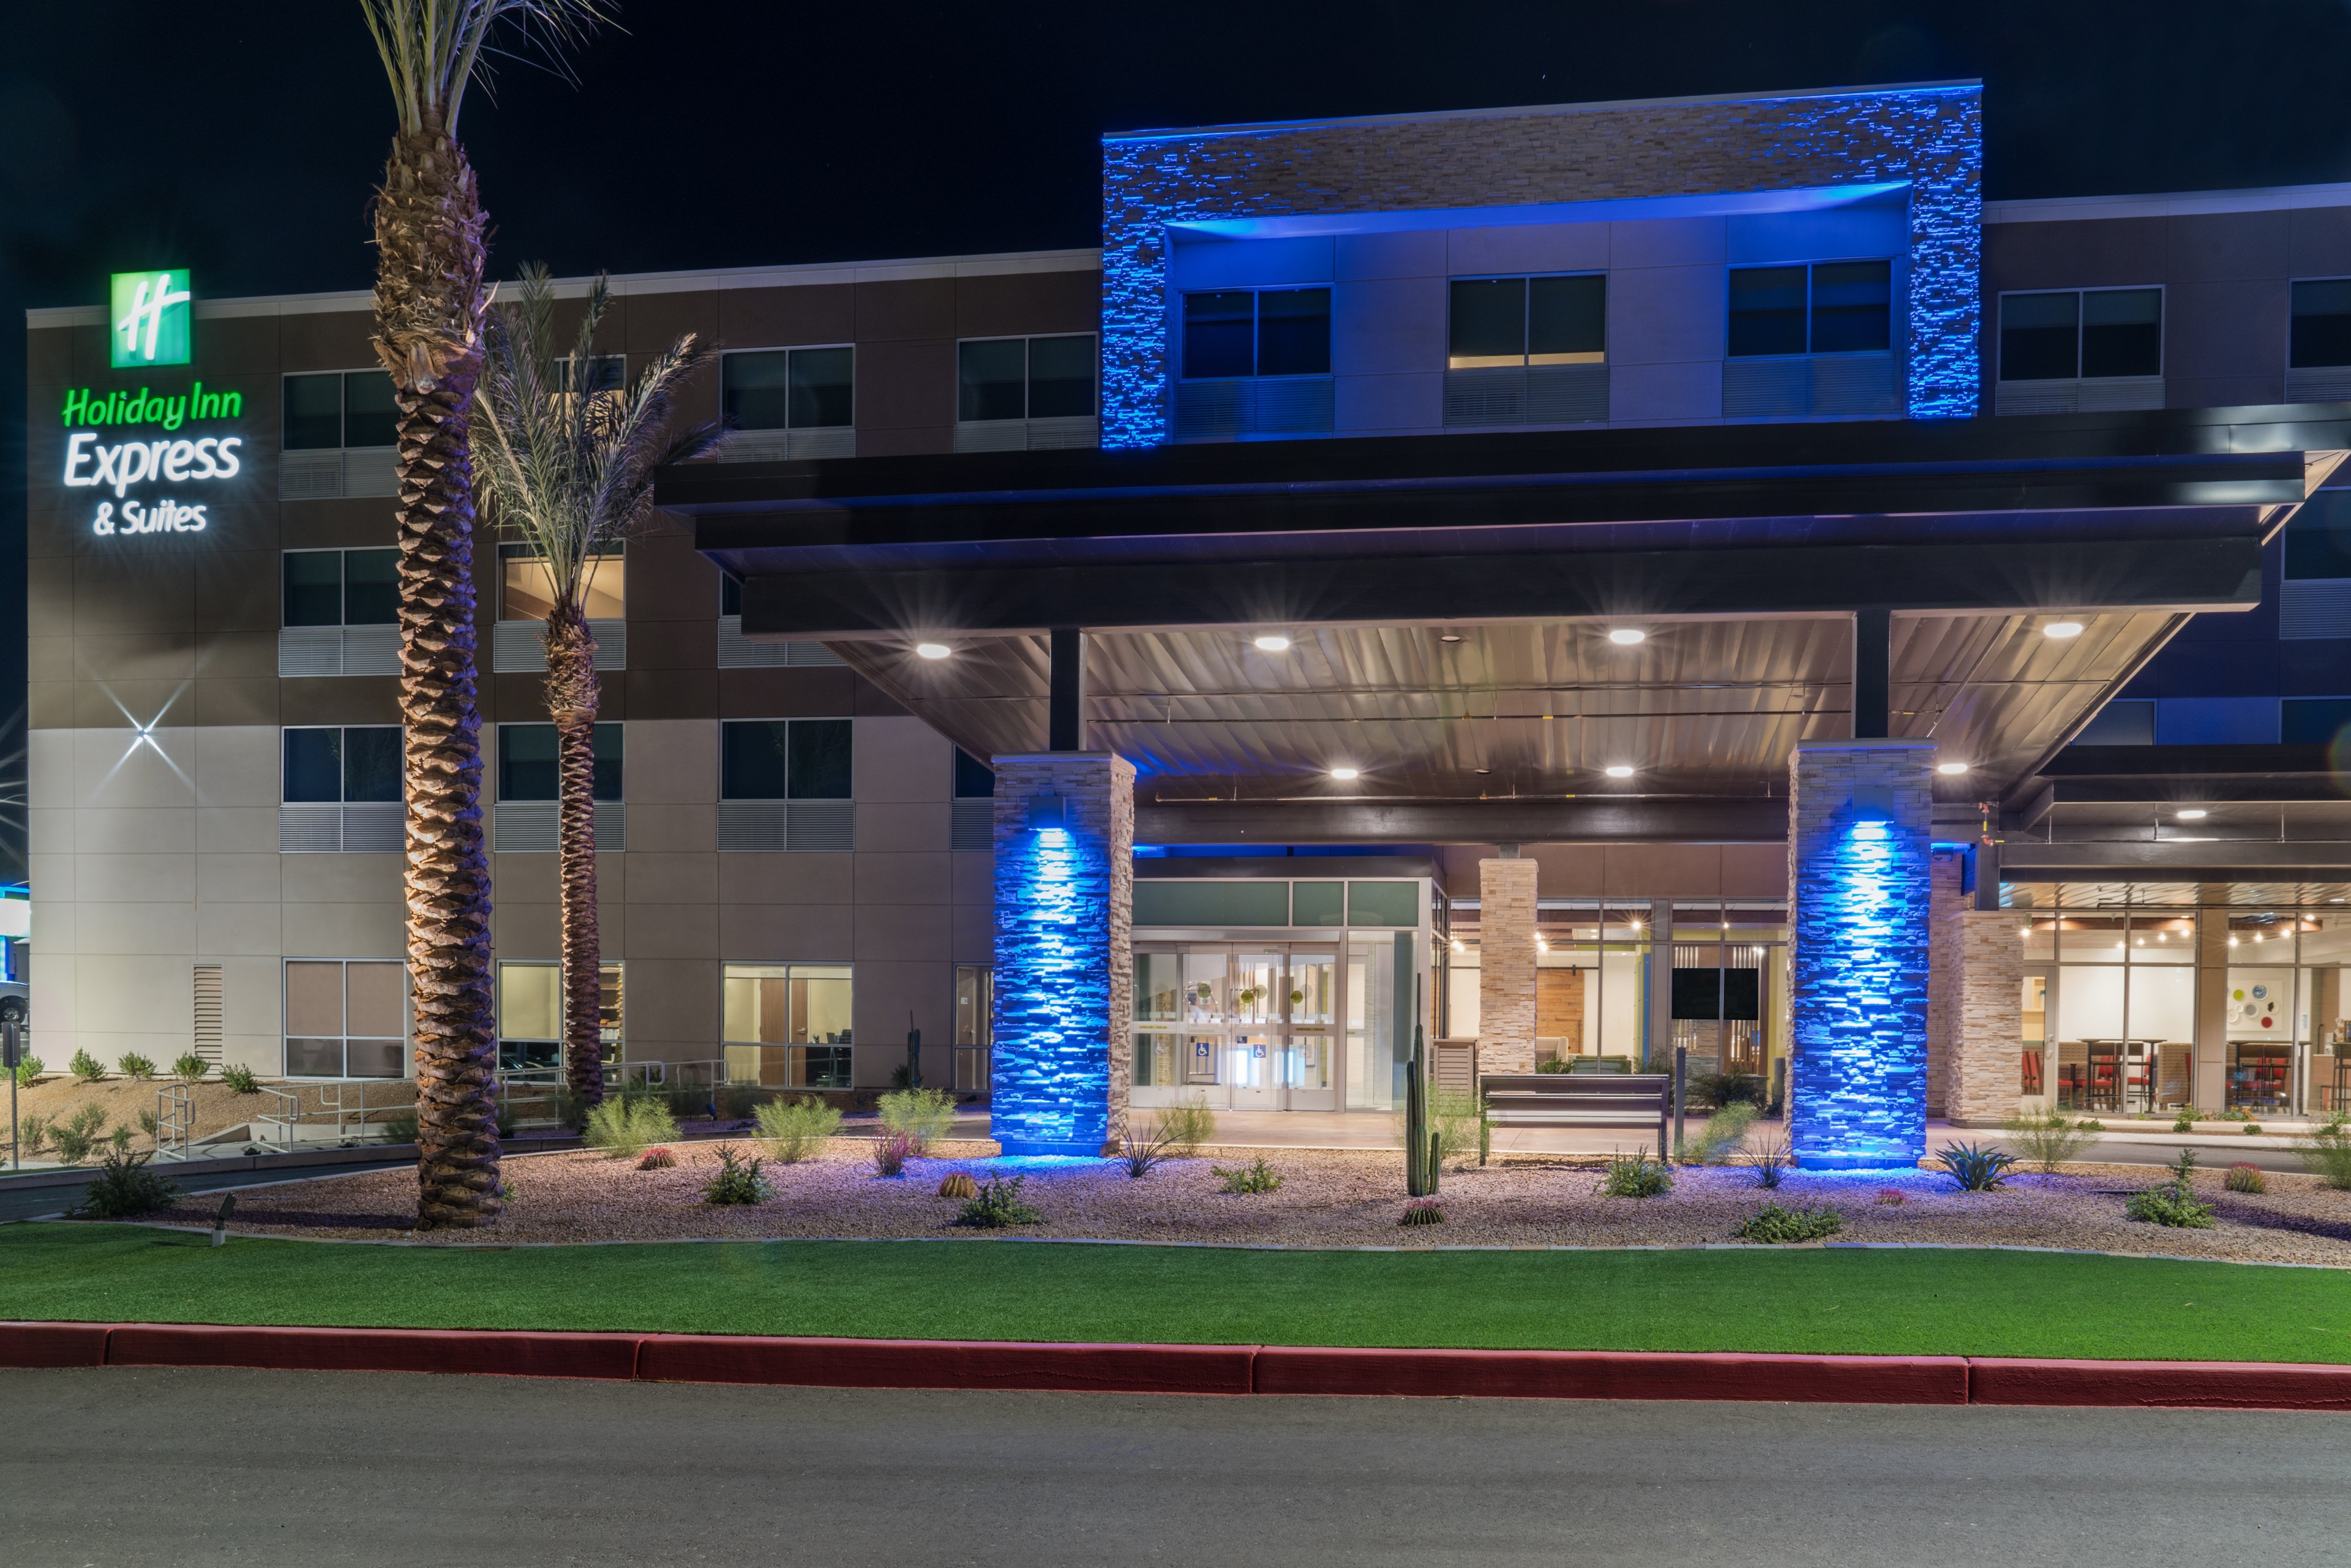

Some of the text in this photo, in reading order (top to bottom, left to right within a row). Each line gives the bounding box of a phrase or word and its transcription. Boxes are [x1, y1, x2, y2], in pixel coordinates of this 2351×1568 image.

[62, 381, 242, 430] Holiday Inn
[63, 432, 242, 498] Express
[93, 499, 208, 536] & Suites
